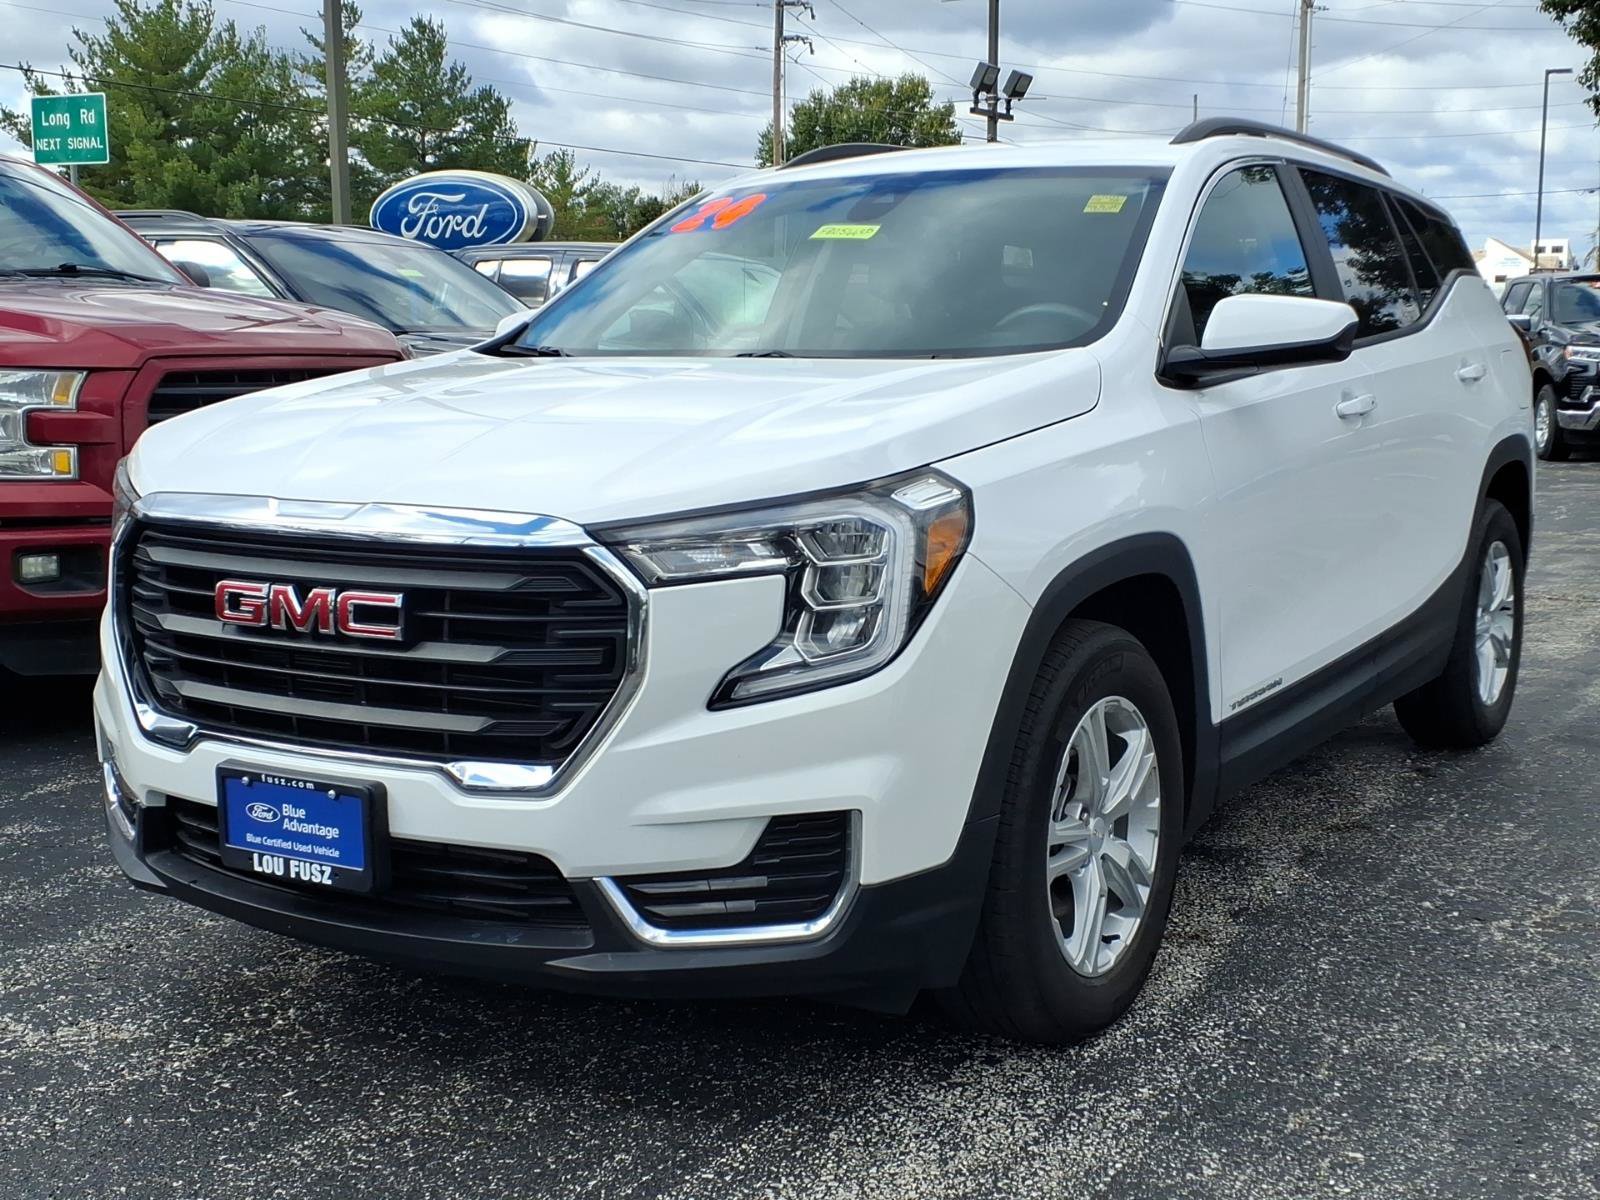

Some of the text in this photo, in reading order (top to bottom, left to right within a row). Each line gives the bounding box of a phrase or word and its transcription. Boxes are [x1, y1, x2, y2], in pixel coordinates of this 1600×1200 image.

[41, 109, 95, 129] Long Rd
[36, 136, 103, 151] NEXT SIGNAL
[400, 192, 488, 239] Ford
[215, 580, 404, 641] GMC
[261, 774, 315, 790] fusz.com
[251, 804, 274, 820] Ford
[282, 803, 306, 819] Blue
[282, 818, 340, 839] Advantage
[246, 832, 340, 858] Blue Certified Used Vehicle
[253, 853, 332, 885] LOU FUSZ
